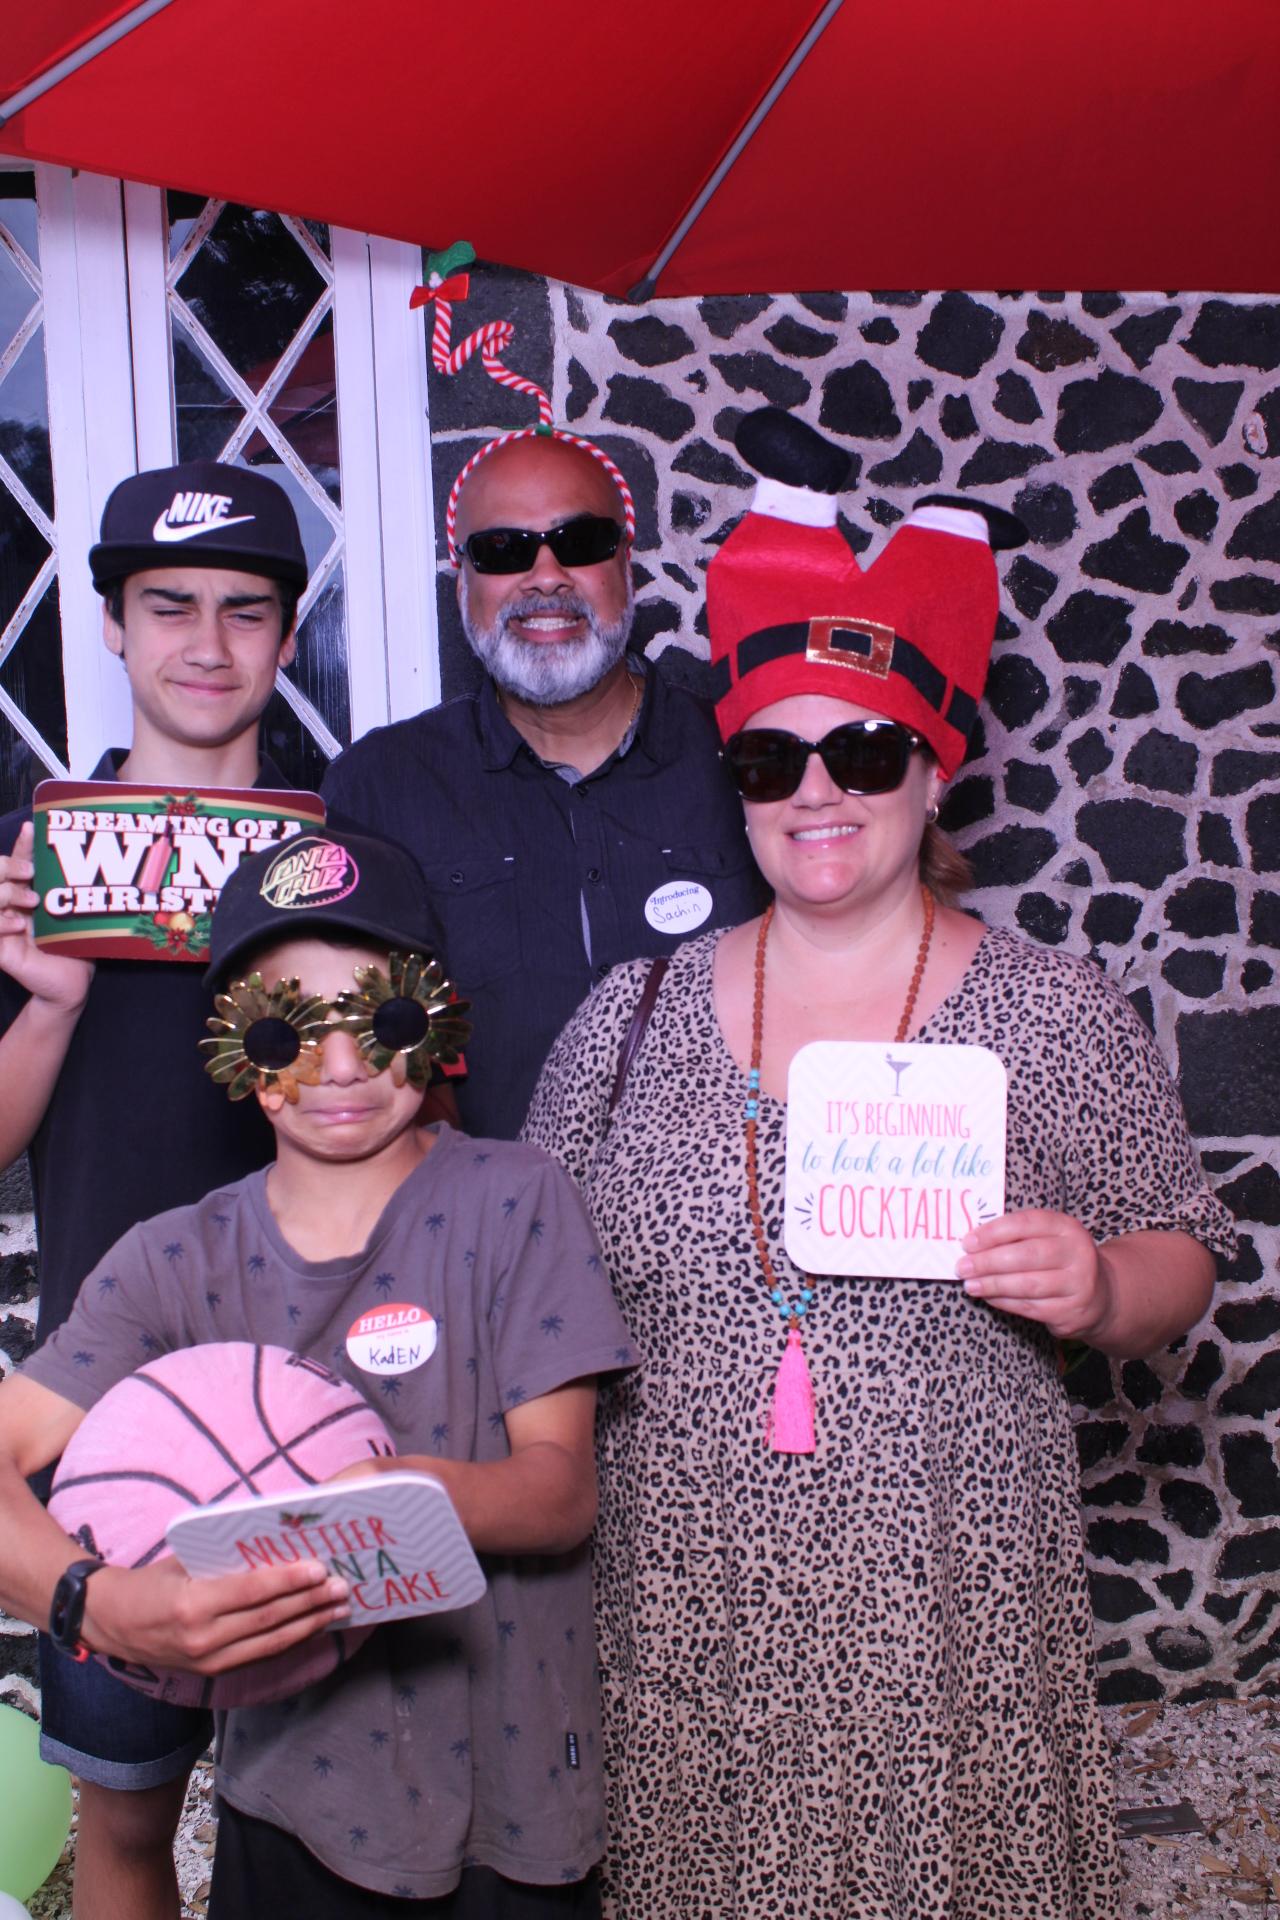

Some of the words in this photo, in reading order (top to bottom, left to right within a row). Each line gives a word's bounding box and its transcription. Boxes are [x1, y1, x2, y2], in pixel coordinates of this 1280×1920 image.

[167, 492, 232, 522] NIKE
[48, 809, 230, 838] DREAMING
[235, 818, 280, 840] OF
[47, 830, 282, 888] WIN
[45, 886, 220, 916] CHRIST
[650, 886, 700, 905] Introducing
[653, 904, 702, 924] Sachin
[826, 1101, 860, 1135] IT'S
[865, 1102, 971, 1138] BEGINNING
[802, 1141, 822, 1173] to
[832, 1139, 880, 1175] look
[889, 1156, 904, 1175] a
[912, 1141, 946, 1178] lot
[952, 1143, 993, 1179] like
[819, 1184, 974, 1241] COCKTAILS
[358, 1307, 421, 1333] HELLO
[234, 1516, 398, 1570] NUTTIER
[376, 1549, 400, 1579] A
[352, 1570, 450, 1611] CAKE
